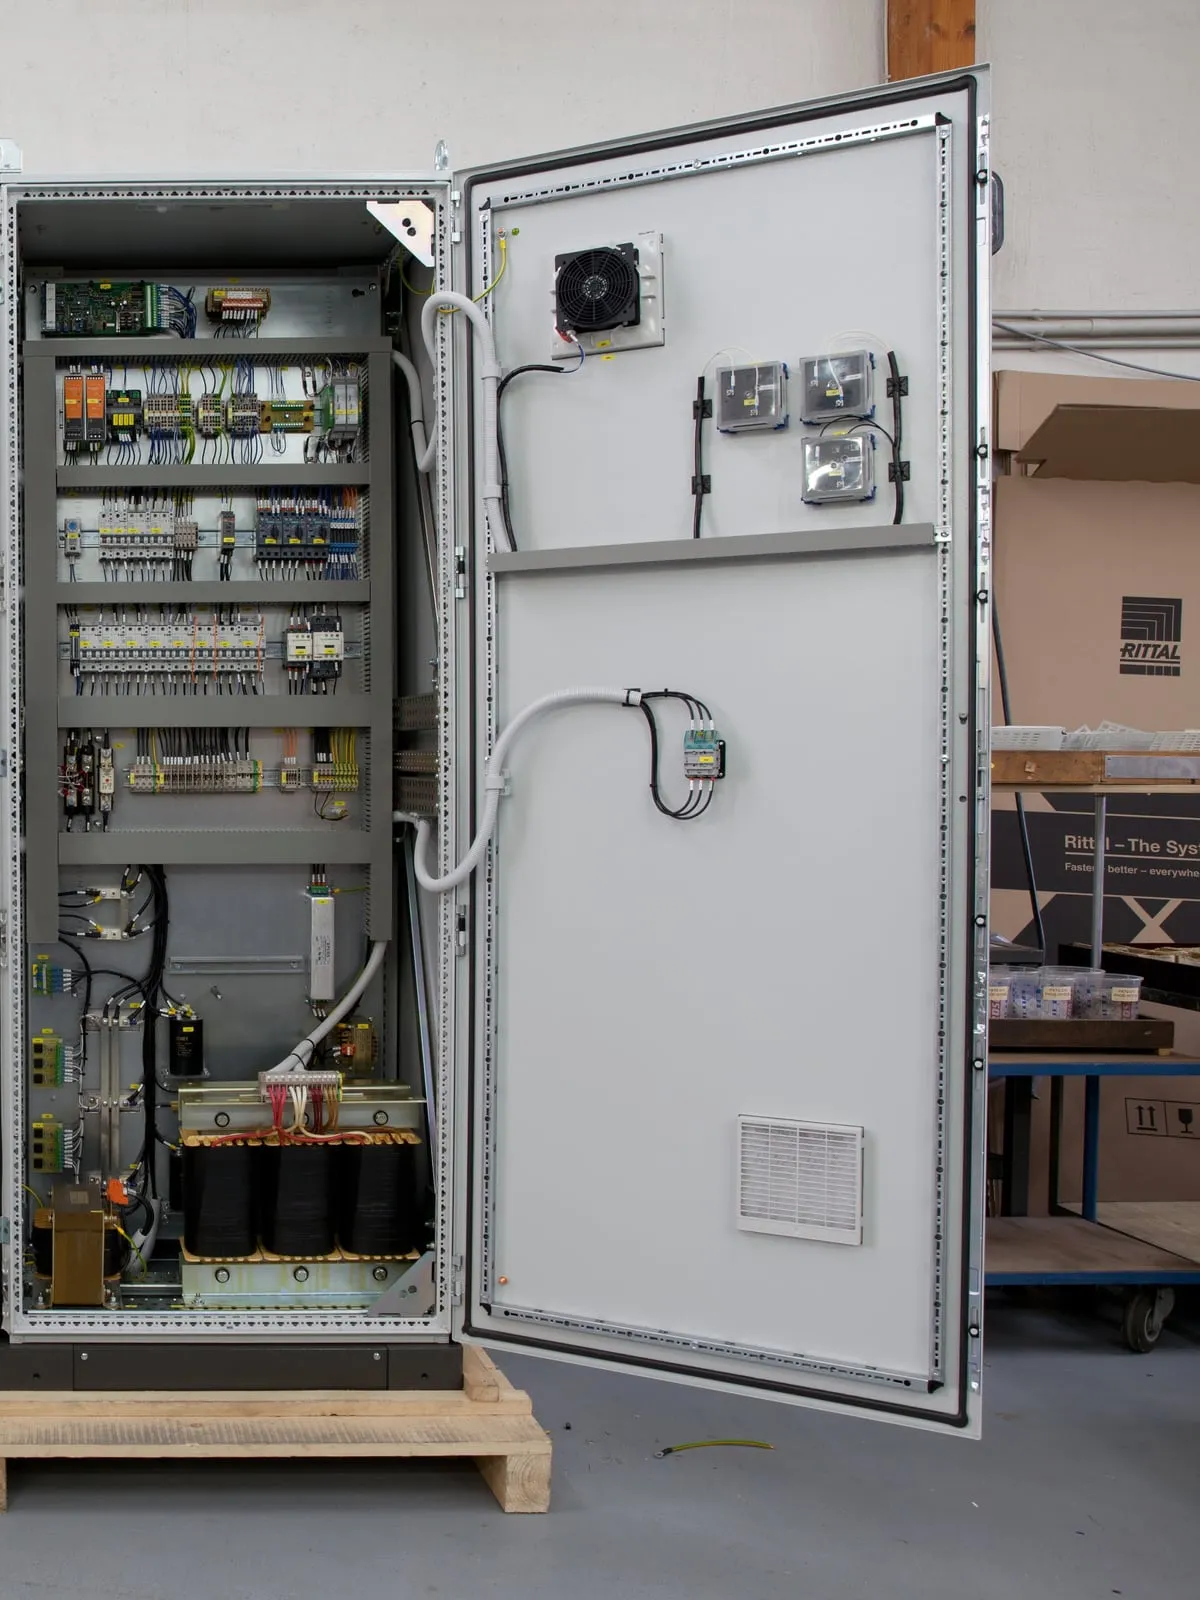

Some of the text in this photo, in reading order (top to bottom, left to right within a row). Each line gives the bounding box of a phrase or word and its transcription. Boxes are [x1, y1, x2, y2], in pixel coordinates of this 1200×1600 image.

[1120, 643, 1180, 660] RITTAL
[1065, 835, 1109, 850] Rittl
[1128, 838, 1160, 853] The
[1107, 864, 1138, 874] better
